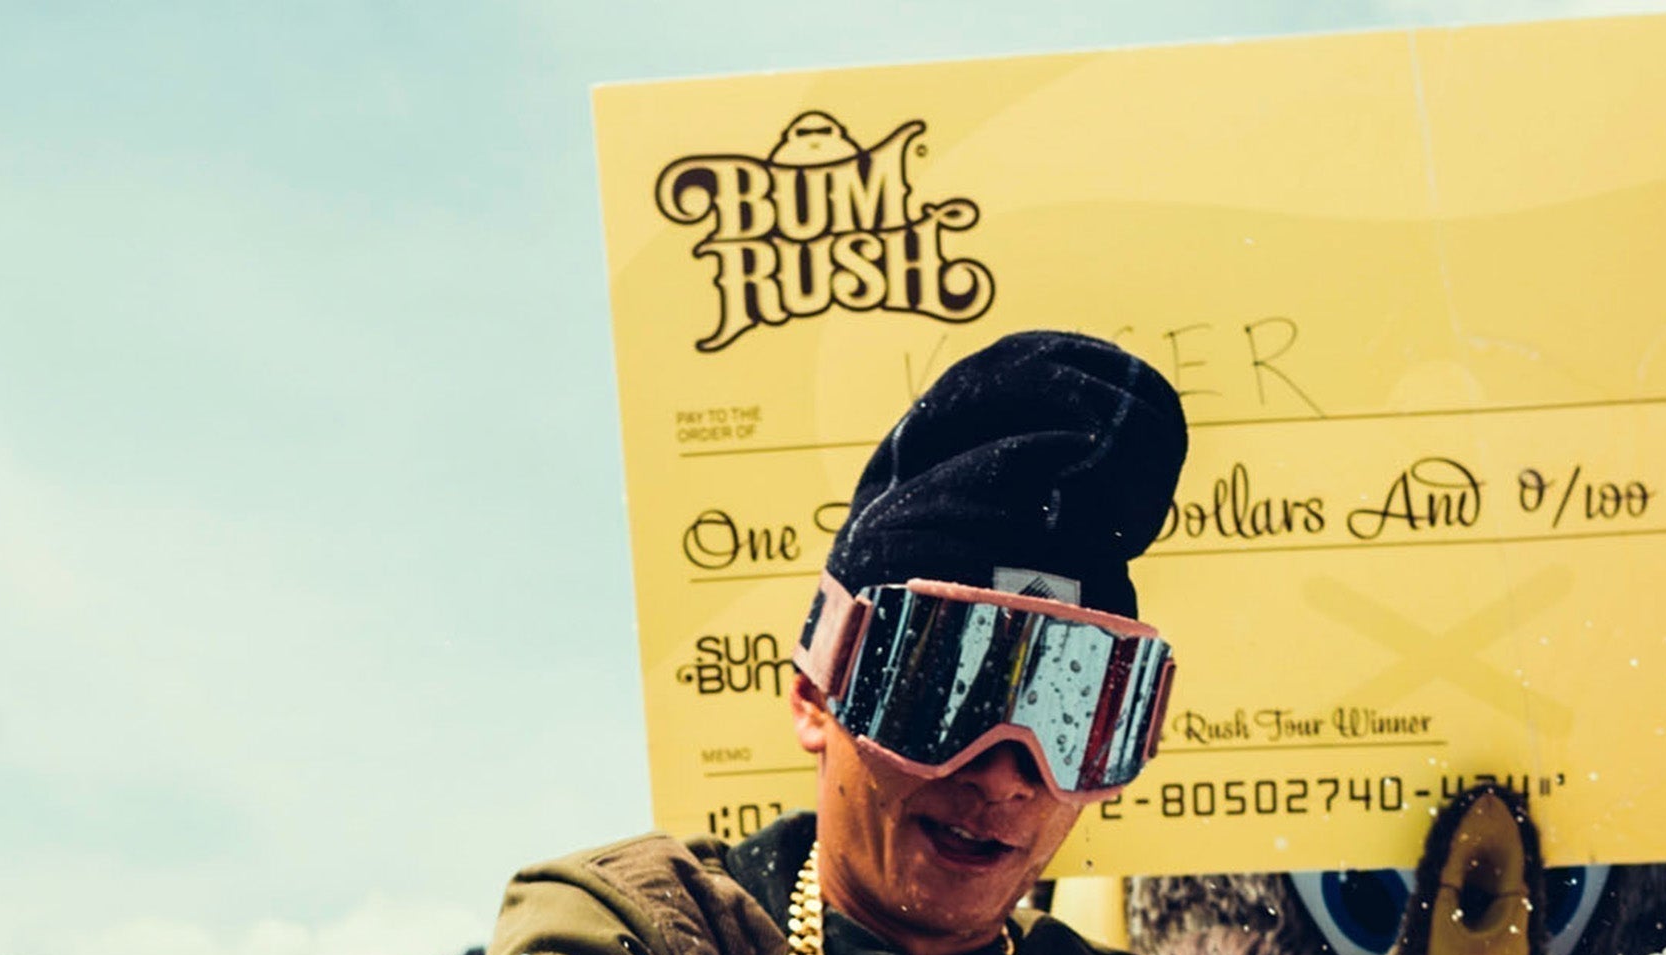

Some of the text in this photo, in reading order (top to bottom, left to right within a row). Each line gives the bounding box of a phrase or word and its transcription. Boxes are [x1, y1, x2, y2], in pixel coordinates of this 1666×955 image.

[654, 118, 928, 245] BUM
[692, 197, 996, 353] RUSH
[676, 406, 762, 424] PAY TO THE
[677, 423, 756, 443] ORDER OF
[683, 508, 801, 570] One
[1347, 457, 1485, 540] And
[695, 633, 778, 666] SUN
[1172, 706, 1433, 745] Rush Tour Winner
[701, 747, 753, 763] MEMO
